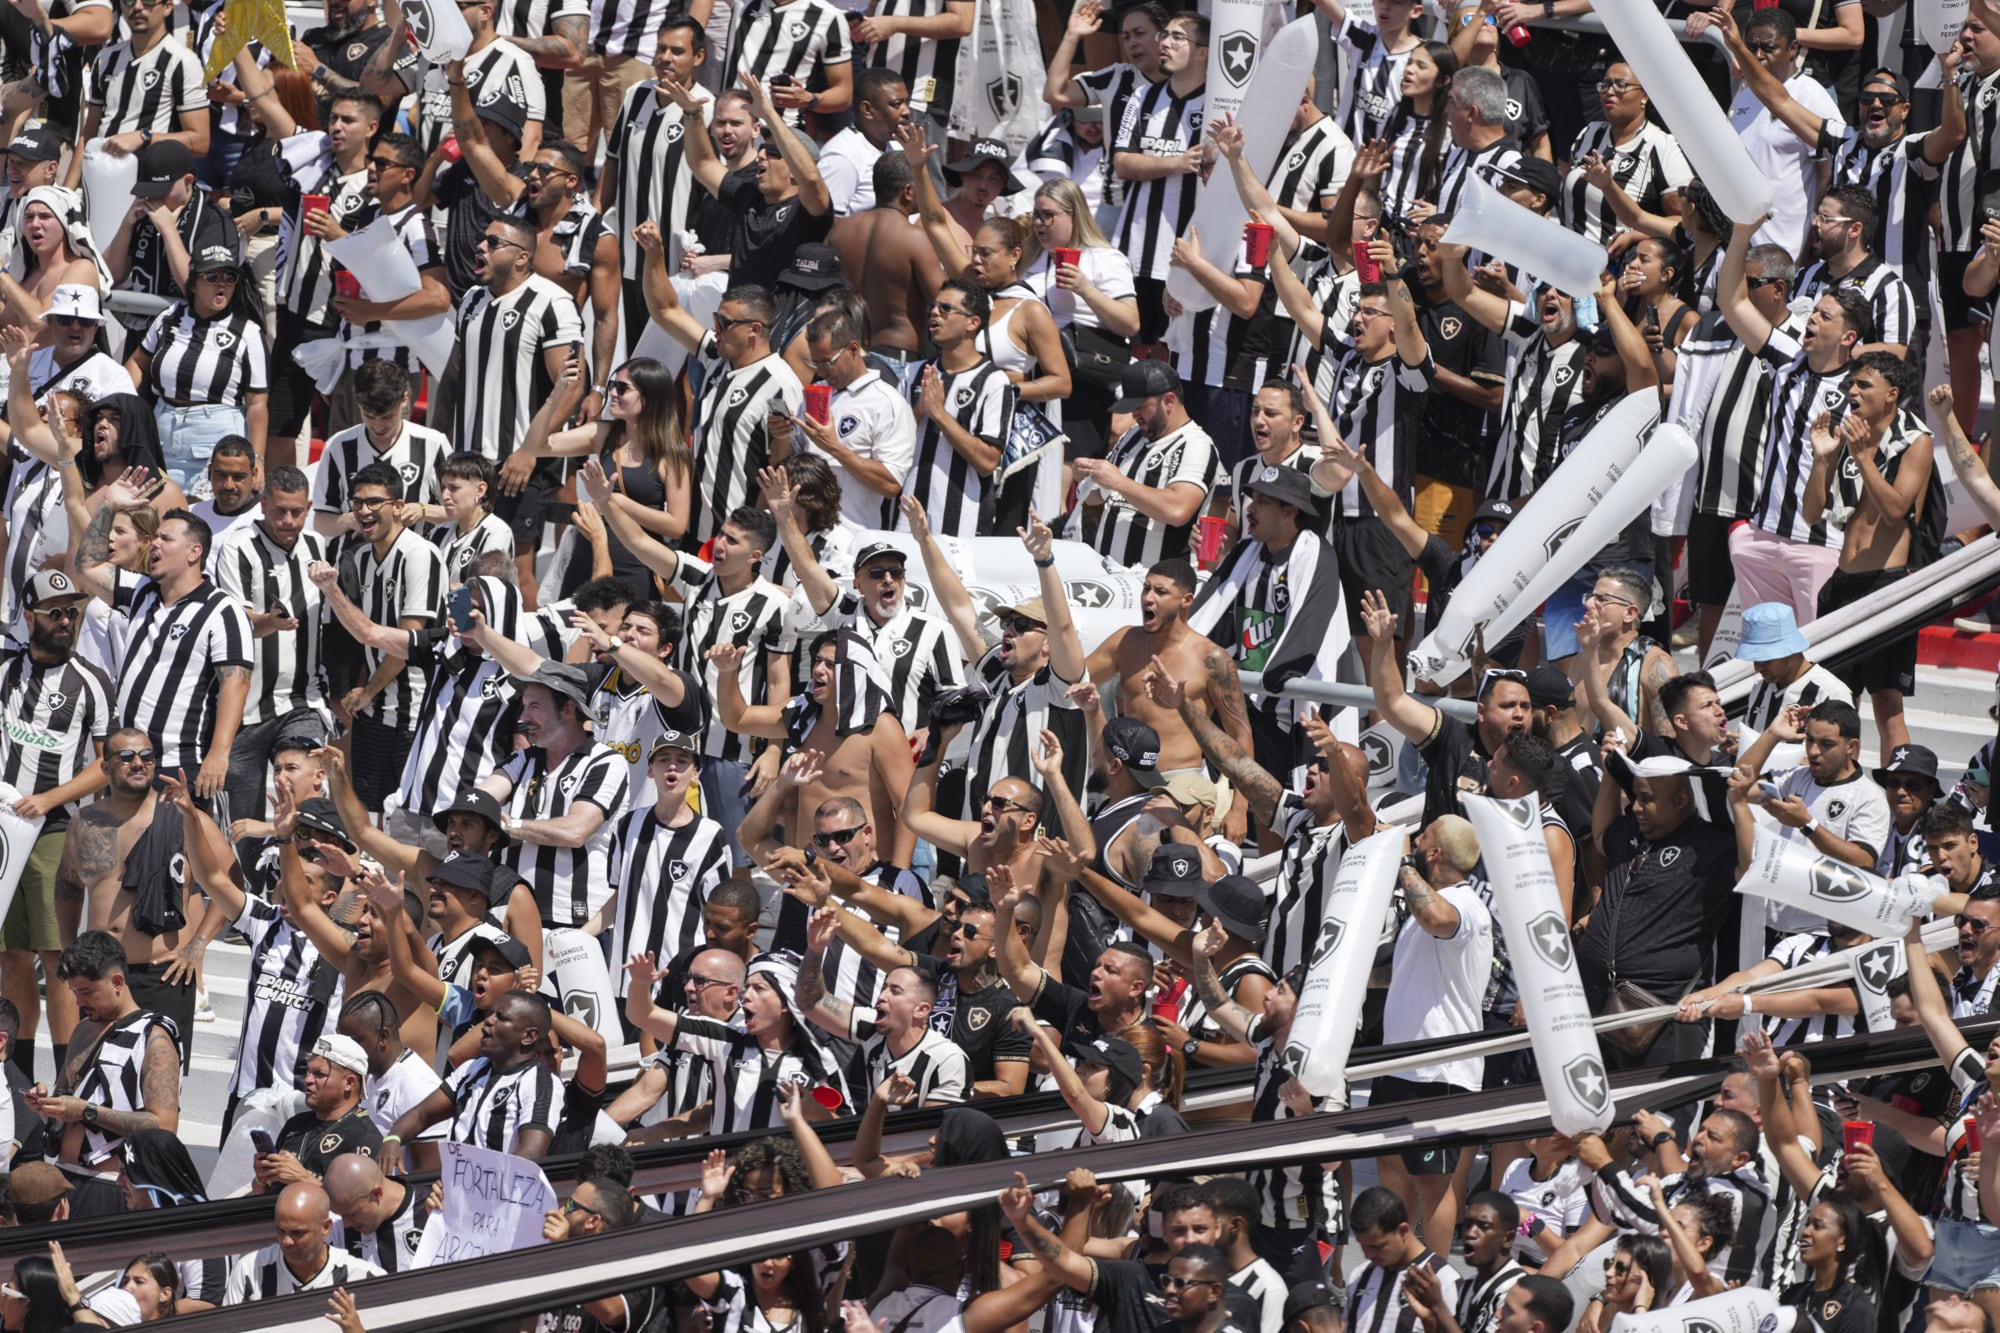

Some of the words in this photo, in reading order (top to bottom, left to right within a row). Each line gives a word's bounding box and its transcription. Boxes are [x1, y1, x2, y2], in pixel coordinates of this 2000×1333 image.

[257, 973, 300, 992] PARI
[255, 985, 316, 1012] MATCH
[447, 1142, 462, 1157] DE
[453, 1159, 546, 1214] FORTALEZA
[472, 1211, 501, 1238] PARA
